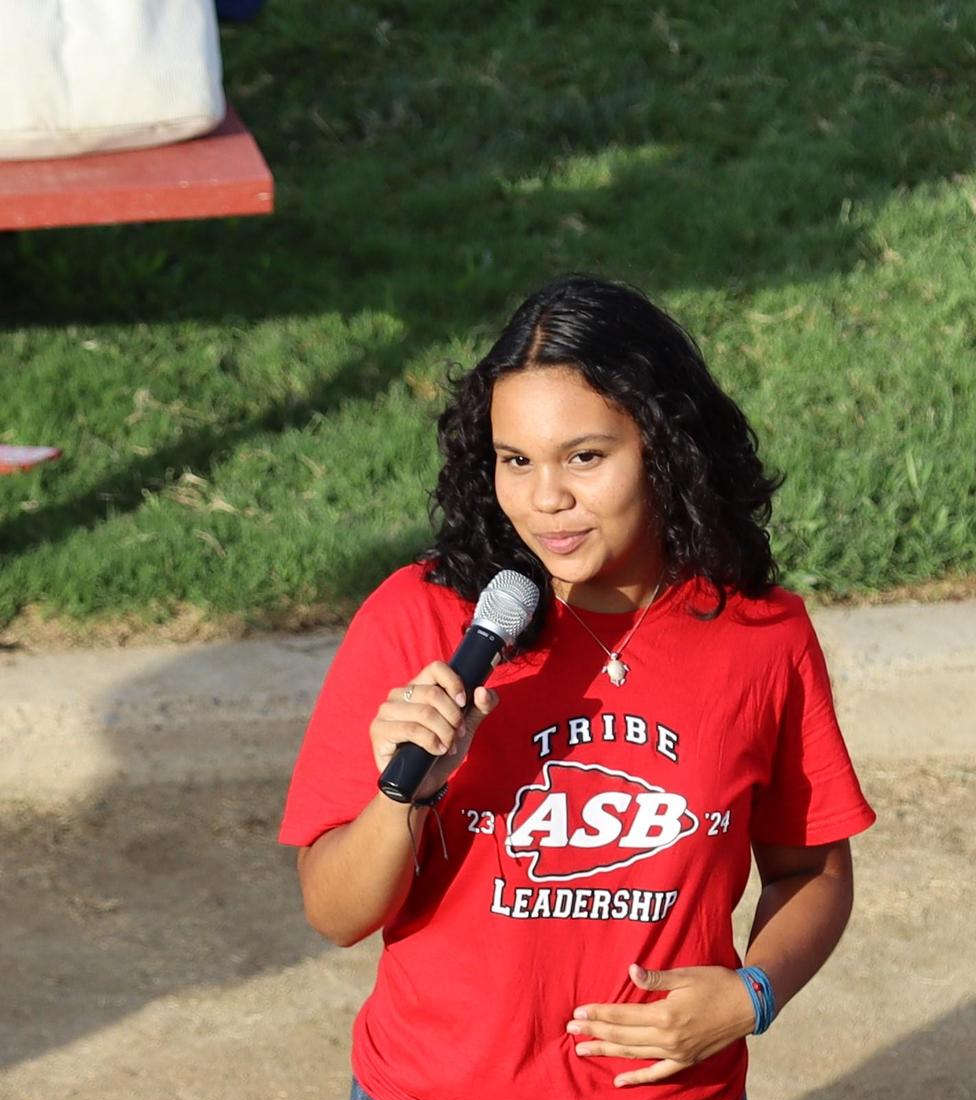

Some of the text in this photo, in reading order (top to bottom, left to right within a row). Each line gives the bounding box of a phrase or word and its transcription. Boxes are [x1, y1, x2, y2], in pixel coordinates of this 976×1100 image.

[534, 714, 679, 761] TRIBE
[504, 791, 688, 849] ASB
[704, 810, 731, 836] '24
[491, 877, 678, 922] LEADERSHIP
